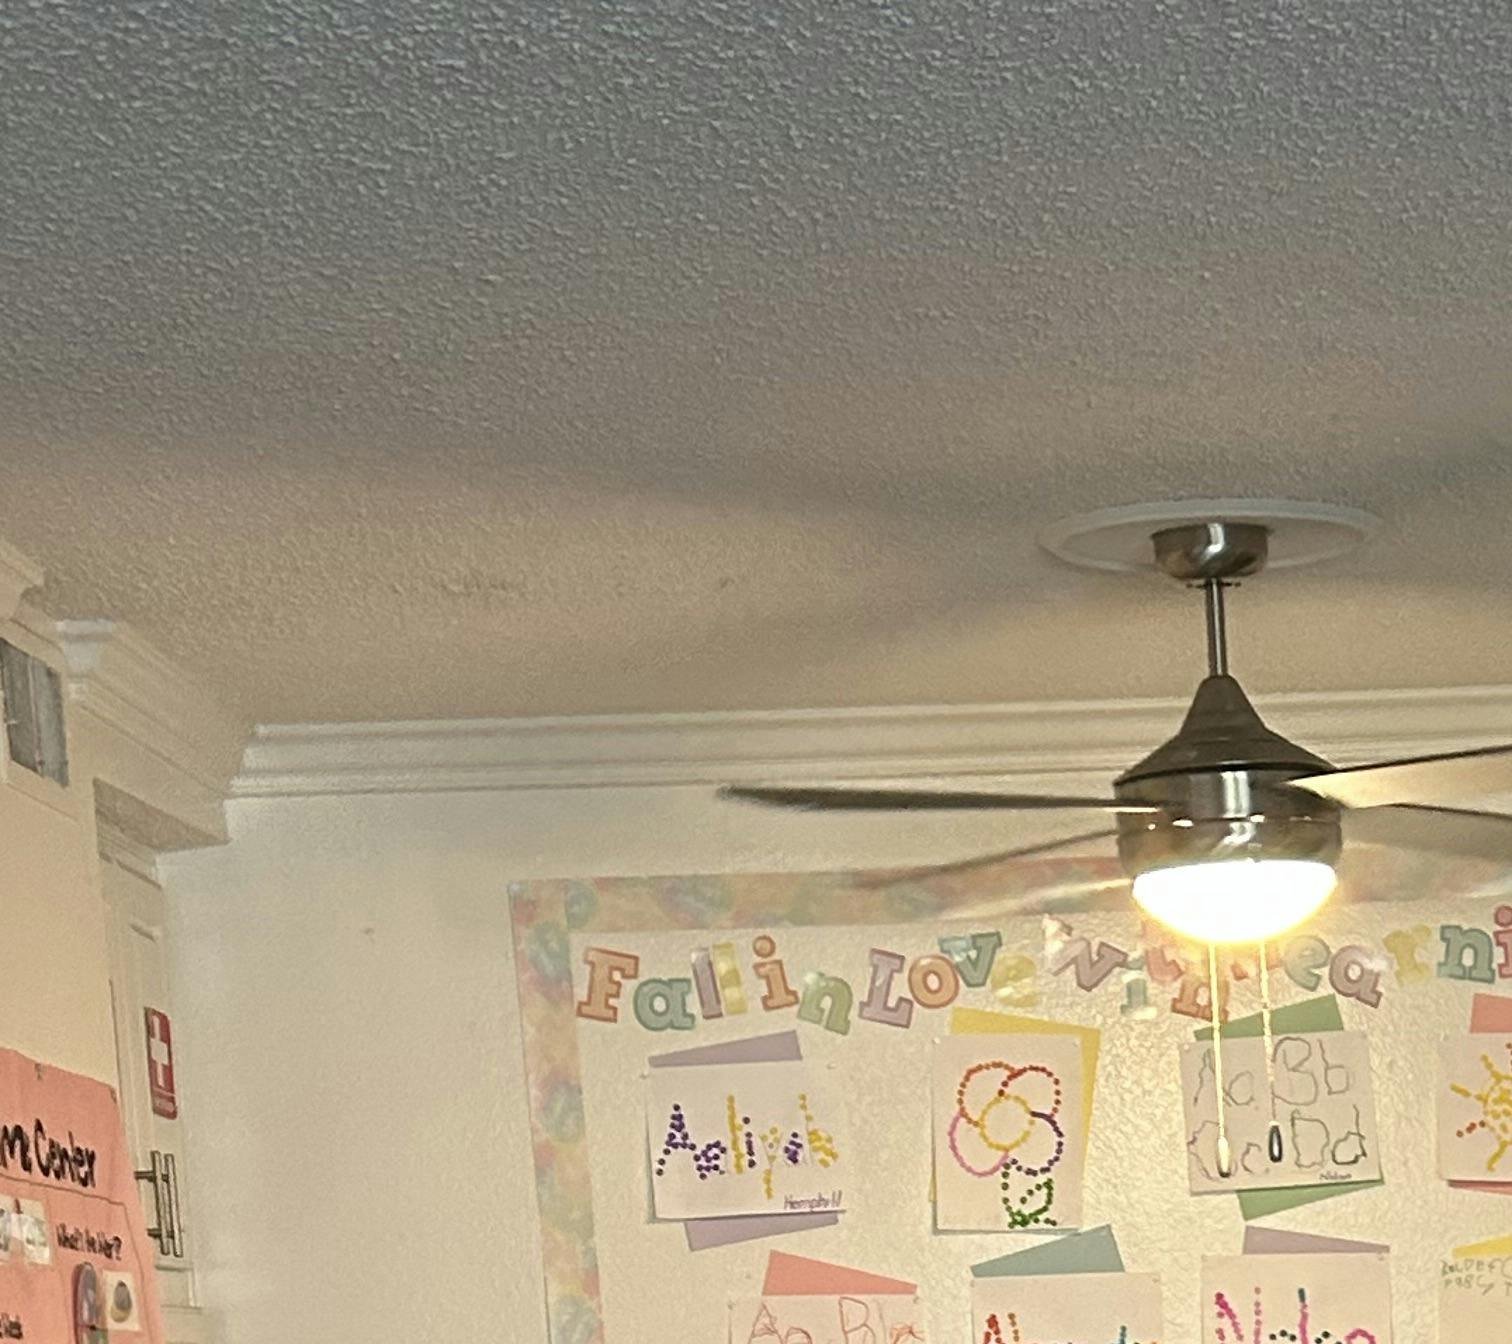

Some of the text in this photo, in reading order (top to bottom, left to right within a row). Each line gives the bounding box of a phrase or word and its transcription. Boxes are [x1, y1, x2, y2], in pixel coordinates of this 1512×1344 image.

[577, 938, 748, 1033] Fall
[752, 934, 853, 1036] in
[858, 931, 1037, 1029] Love
